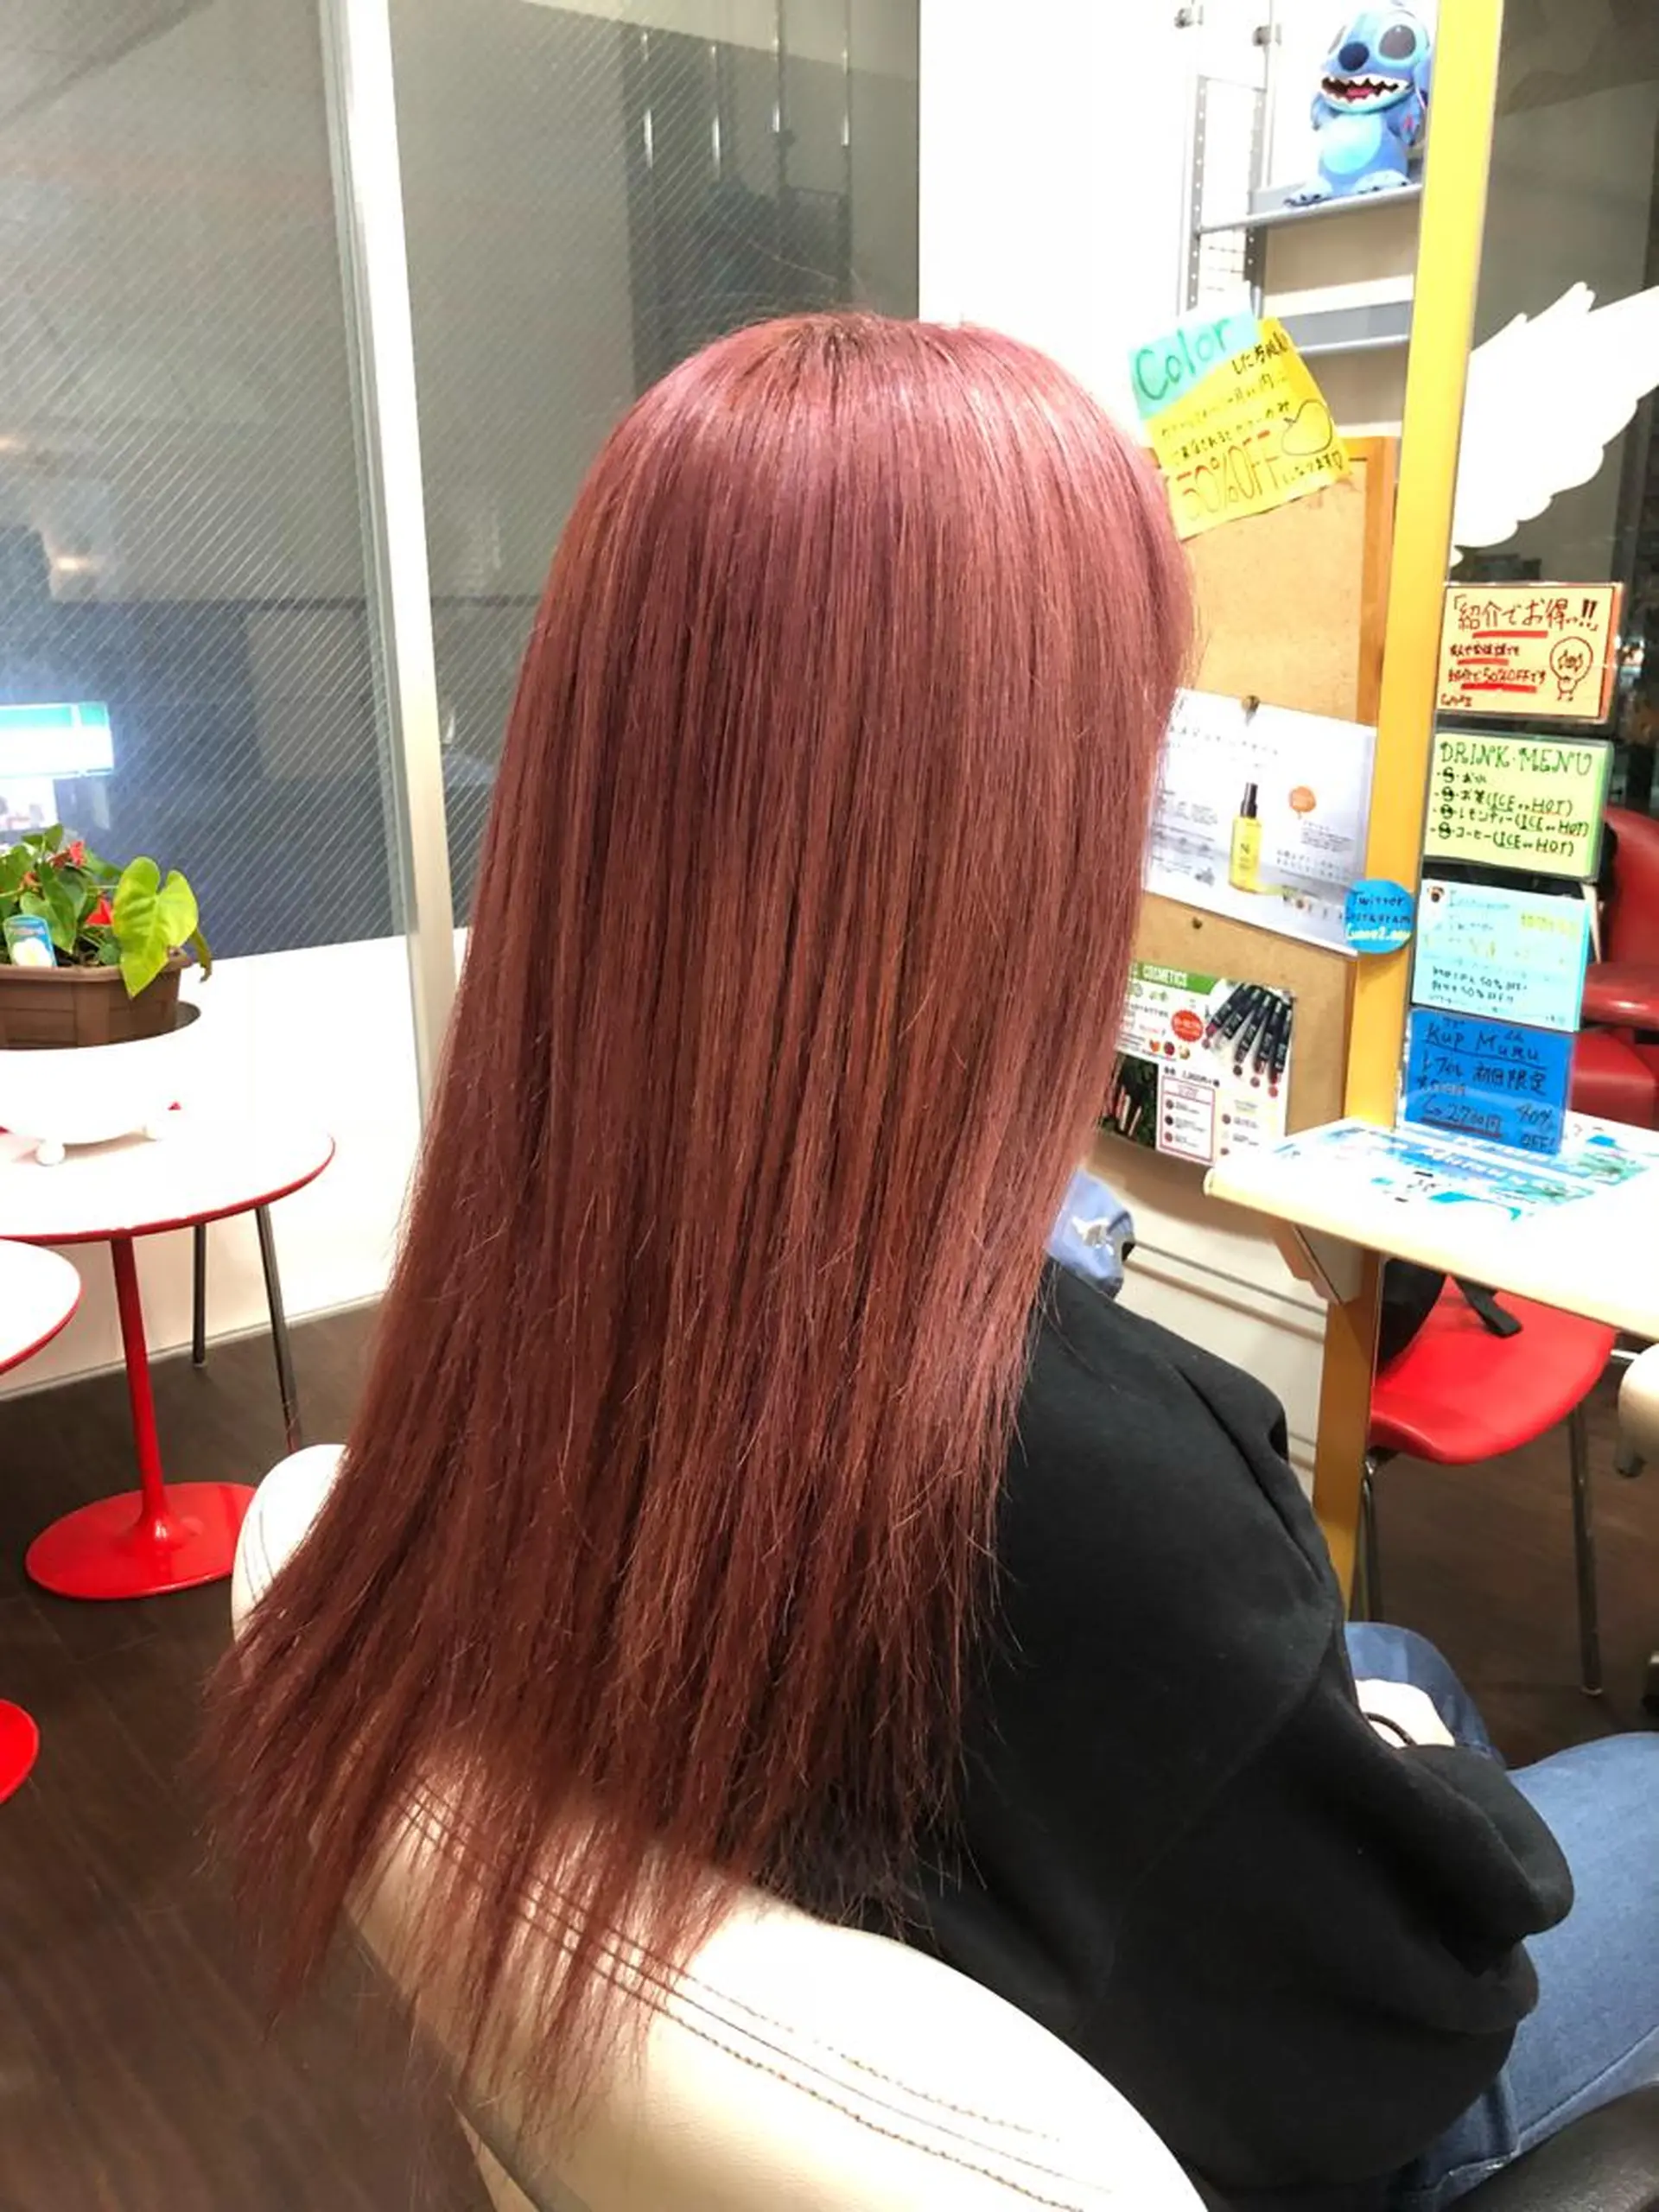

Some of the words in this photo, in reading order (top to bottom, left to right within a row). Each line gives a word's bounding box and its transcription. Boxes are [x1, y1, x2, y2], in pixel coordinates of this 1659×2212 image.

[1135, 317, 1231, 401] Color
[1440, 741, 1510, 768] DRINK
[1517, 746, 1592, 776] MENU
